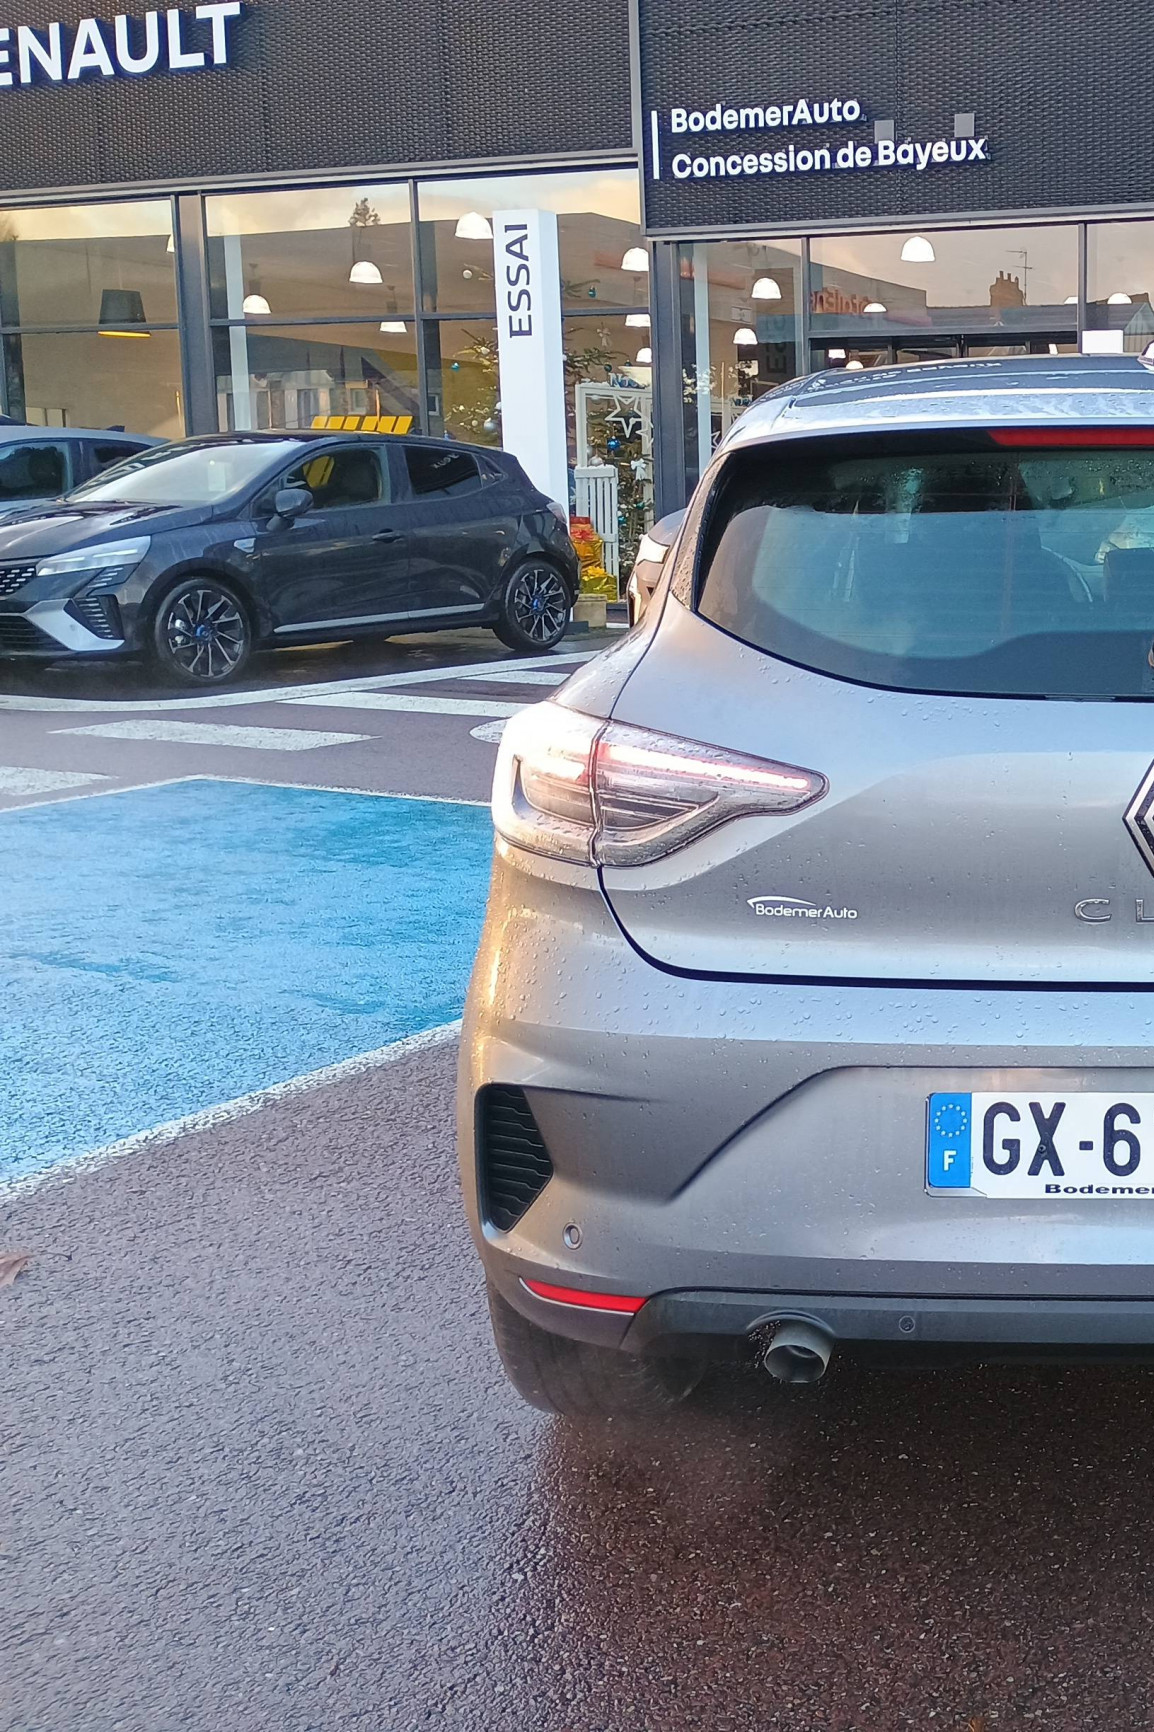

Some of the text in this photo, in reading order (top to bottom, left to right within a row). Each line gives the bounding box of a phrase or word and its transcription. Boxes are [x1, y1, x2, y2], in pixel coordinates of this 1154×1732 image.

[670, 98, 861, 133] BodemerAuto
[671, 138, 988, 179] Concession de Bayeux
[504, 223, 533, 339] ESSAI
[755, 903, 858, 919] BodemerAuto
[943, 1150, 957, 1171] F
